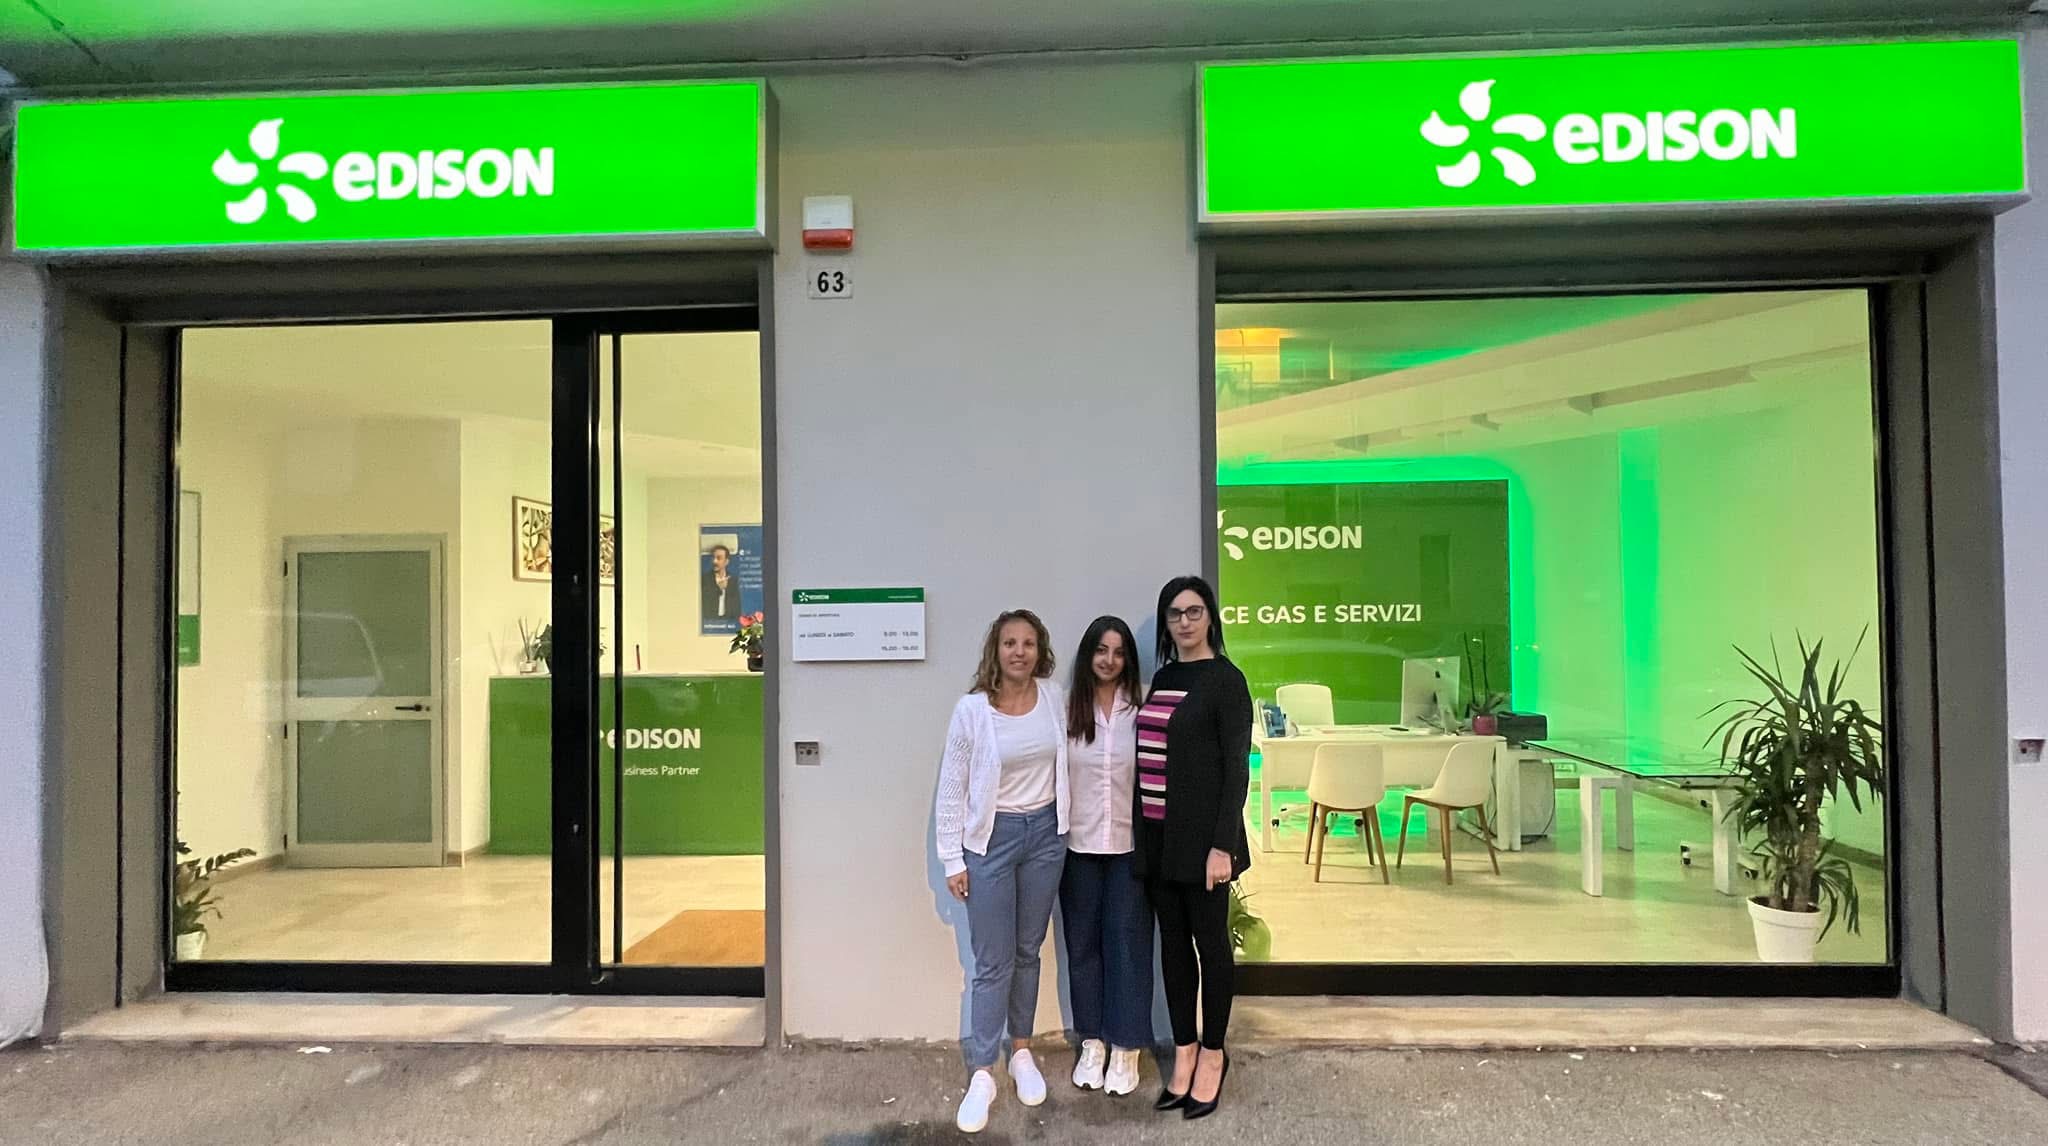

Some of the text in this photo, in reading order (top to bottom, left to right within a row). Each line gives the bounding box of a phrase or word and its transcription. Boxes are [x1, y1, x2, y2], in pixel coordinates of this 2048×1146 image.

[1552, 107, 1797, 163] eDISON
[332, 147, 555, 201] eDISON
[817, 271, 844, 293] 63
[1251, 525, 1362, 551] eDISON
[1257, 605, 1306, 624] GAS
[1314, 605, 1327, 623] E
[1334, 604, 1421, 623] SERVIZI
[661, 765, 701, 777] Partner
